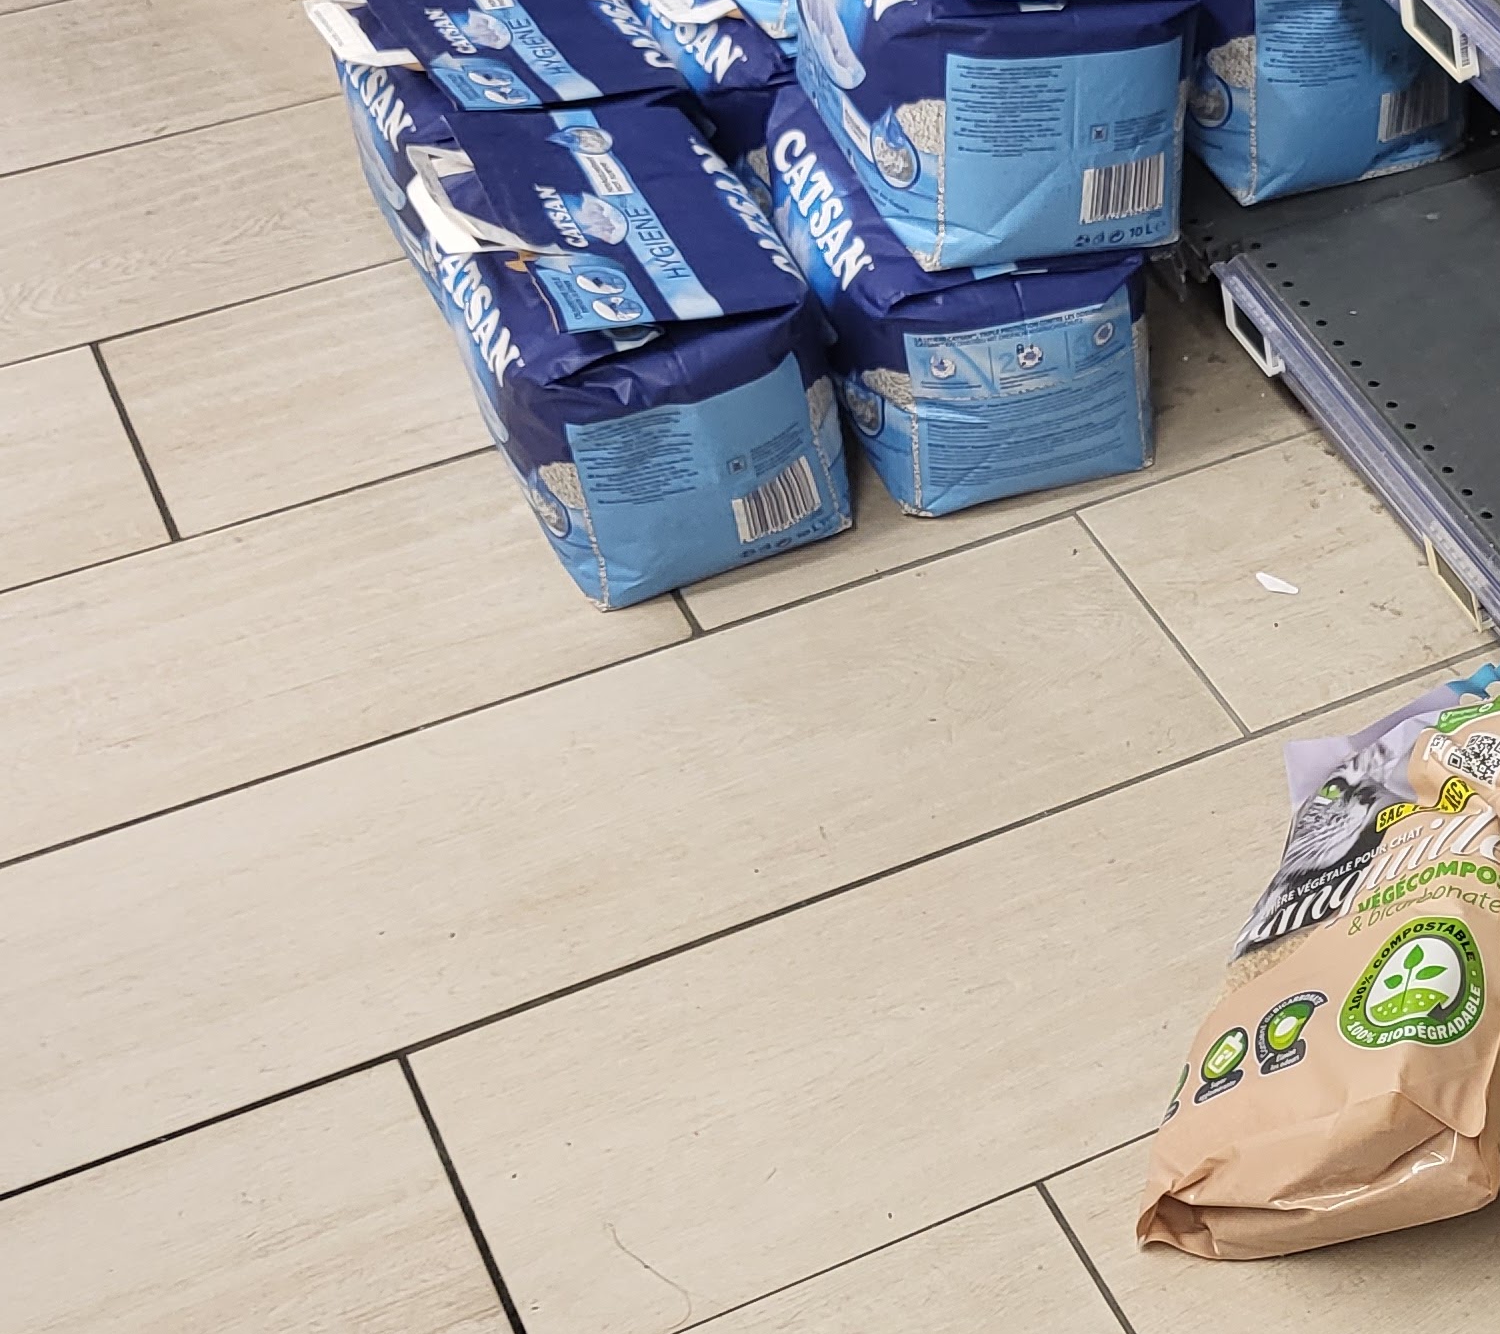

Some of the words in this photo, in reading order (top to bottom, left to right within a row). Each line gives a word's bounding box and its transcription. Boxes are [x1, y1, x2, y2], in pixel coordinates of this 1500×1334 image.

[423, 7, 478, 55] CATSAN
[507, 14, 572, 76] HYGIENE
[533, 182, 590, 249] CATSAN
[625, 205, 693, 281] HYGIENE
[772, 128, 869, 293] CATSAN
[1378, 803, 1405, 829] SAC
[1295, 859, 1355, 898] VÉGÉTALE
[1353, 843, 1388, 871] POUR
[1389, 825, 1424, 850] CHAT
[1347, 915, 1362, 936] &
[1348, 973, 1375, 1012] 100%
[1372, 920, 1476, 970] COMPOSTABLE
[1348, 1020, 1377, 1046] 100%
[1375, 983, 1482, 1046] BIODÉGRADABLE
